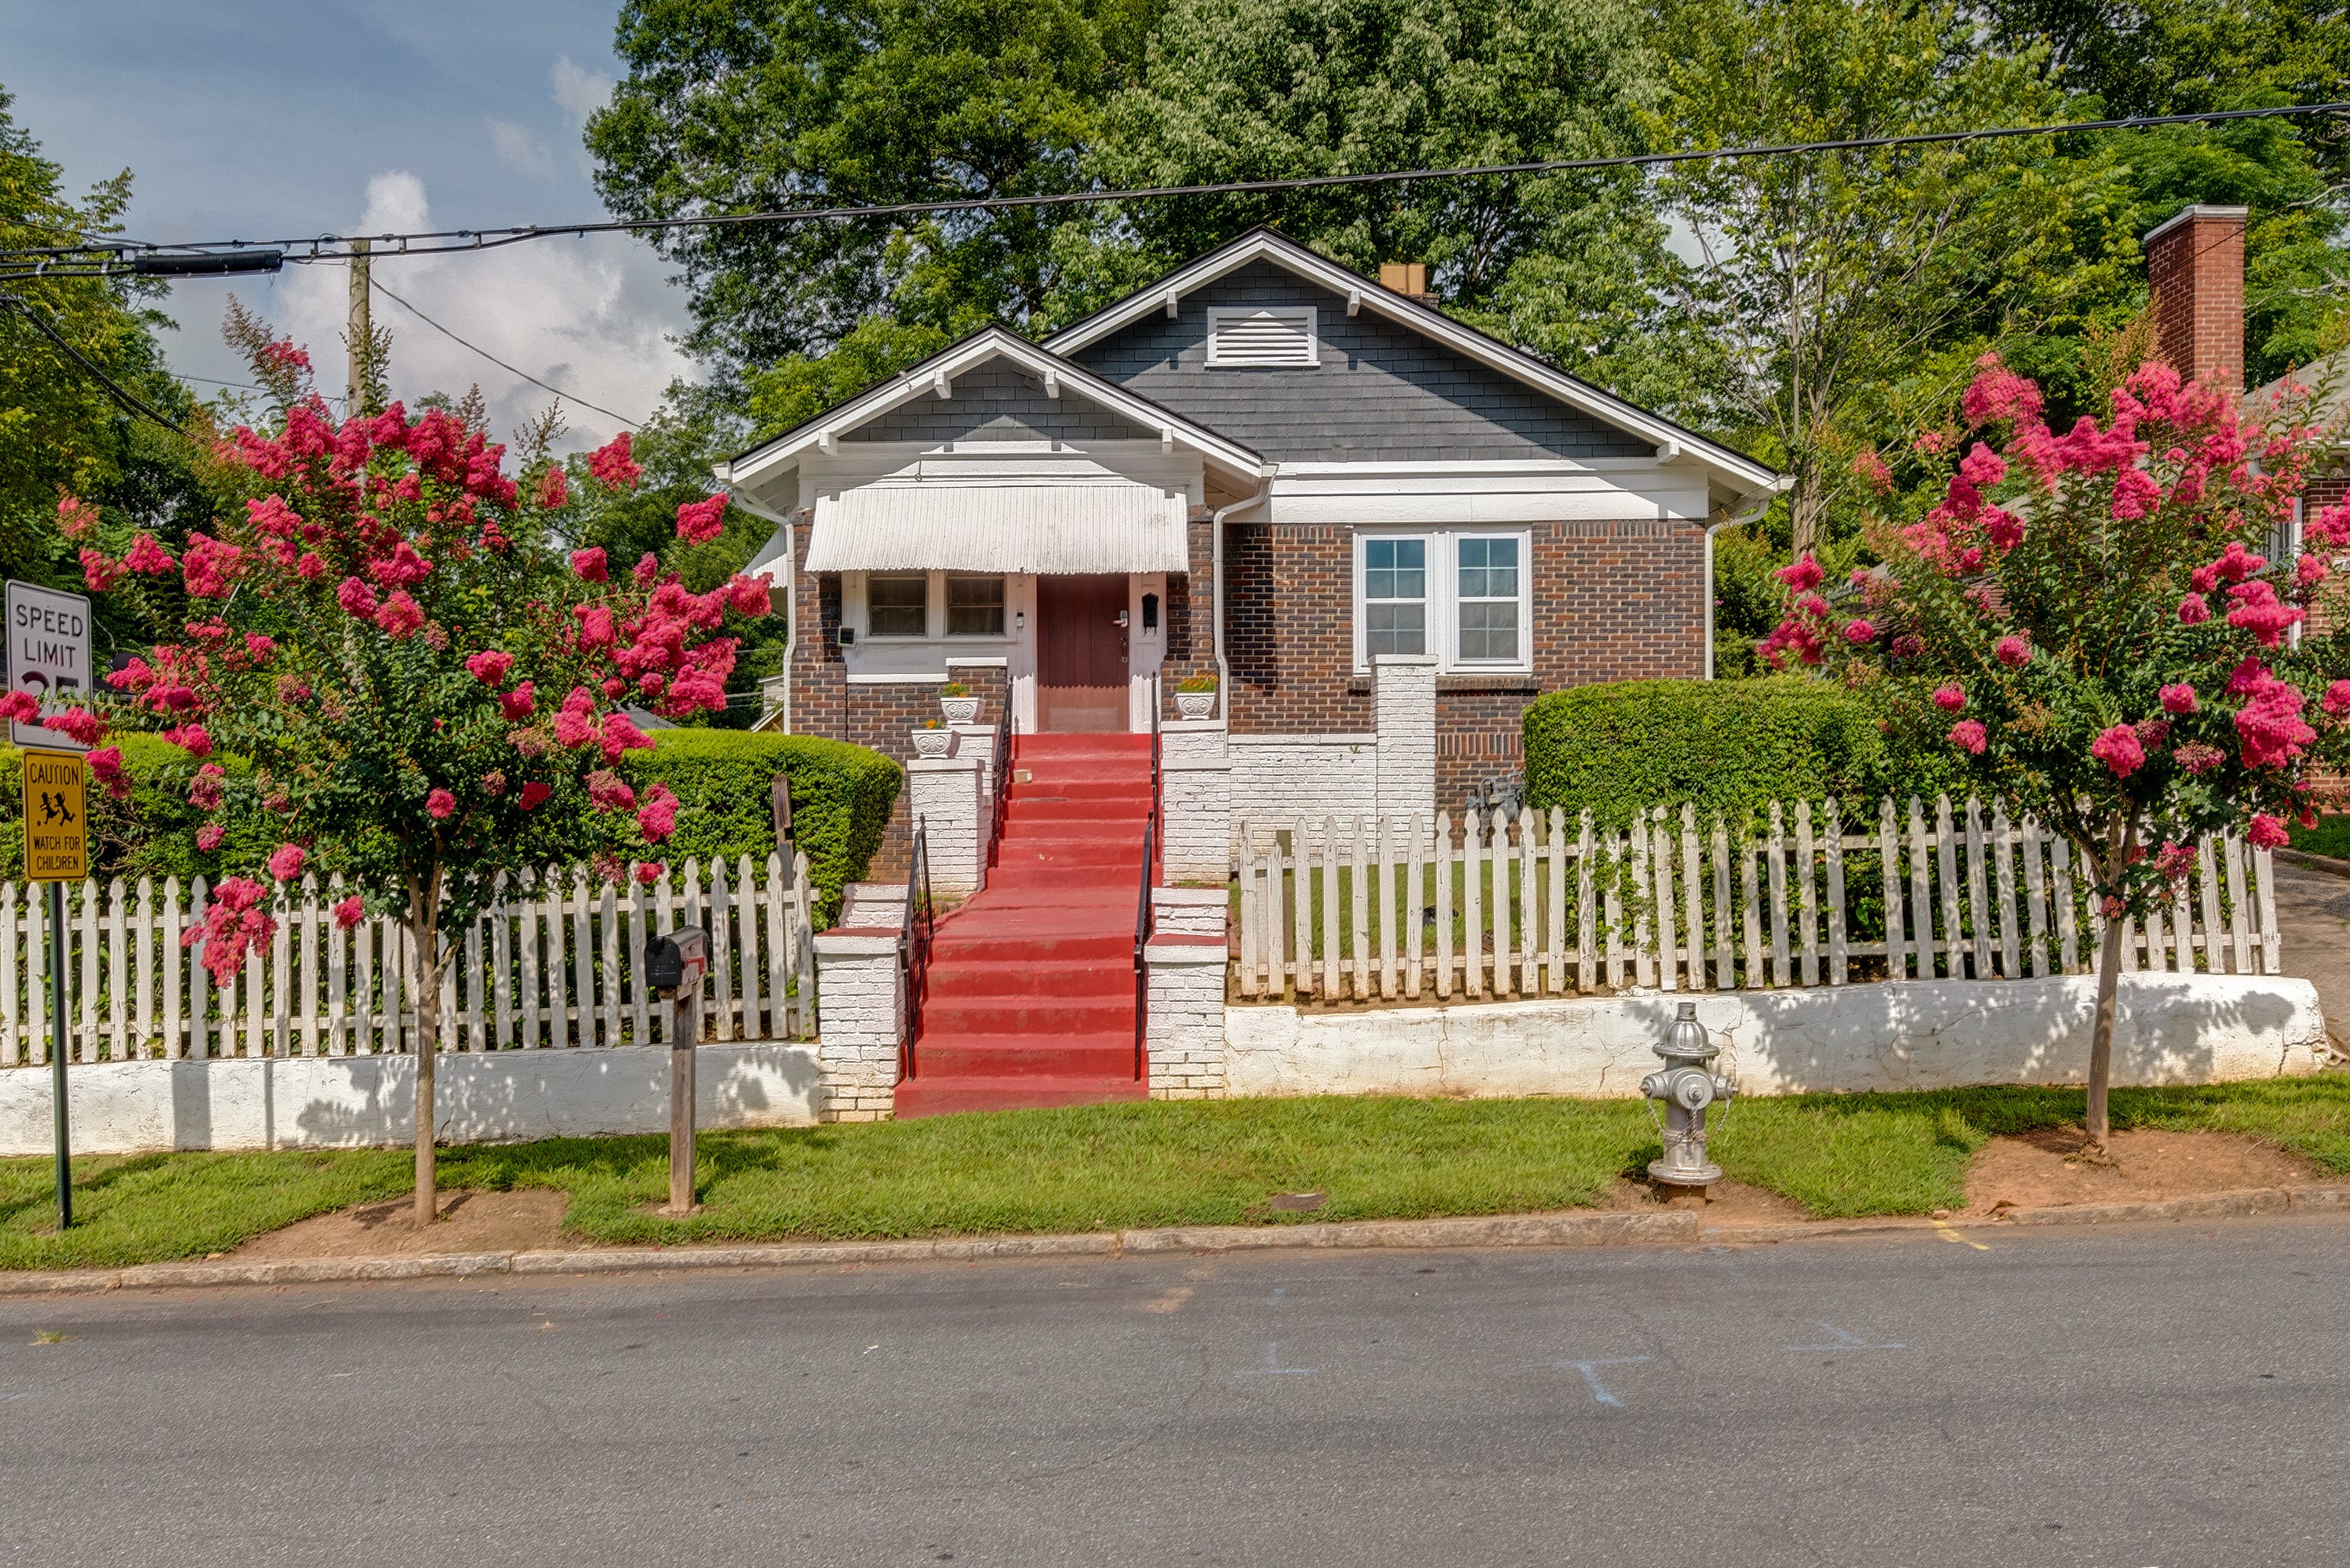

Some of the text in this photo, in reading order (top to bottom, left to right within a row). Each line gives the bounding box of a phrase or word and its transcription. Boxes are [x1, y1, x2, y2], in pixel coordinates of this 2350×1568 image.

[16, 603, 83, 638] SPEED
[24, 638, 76, 668] LIMIT
[30, 762, 78, 785] CAUTION
[33, 835, 81, 850] WATCH FOR
[37, 855, 78, 870] CHILDREN
